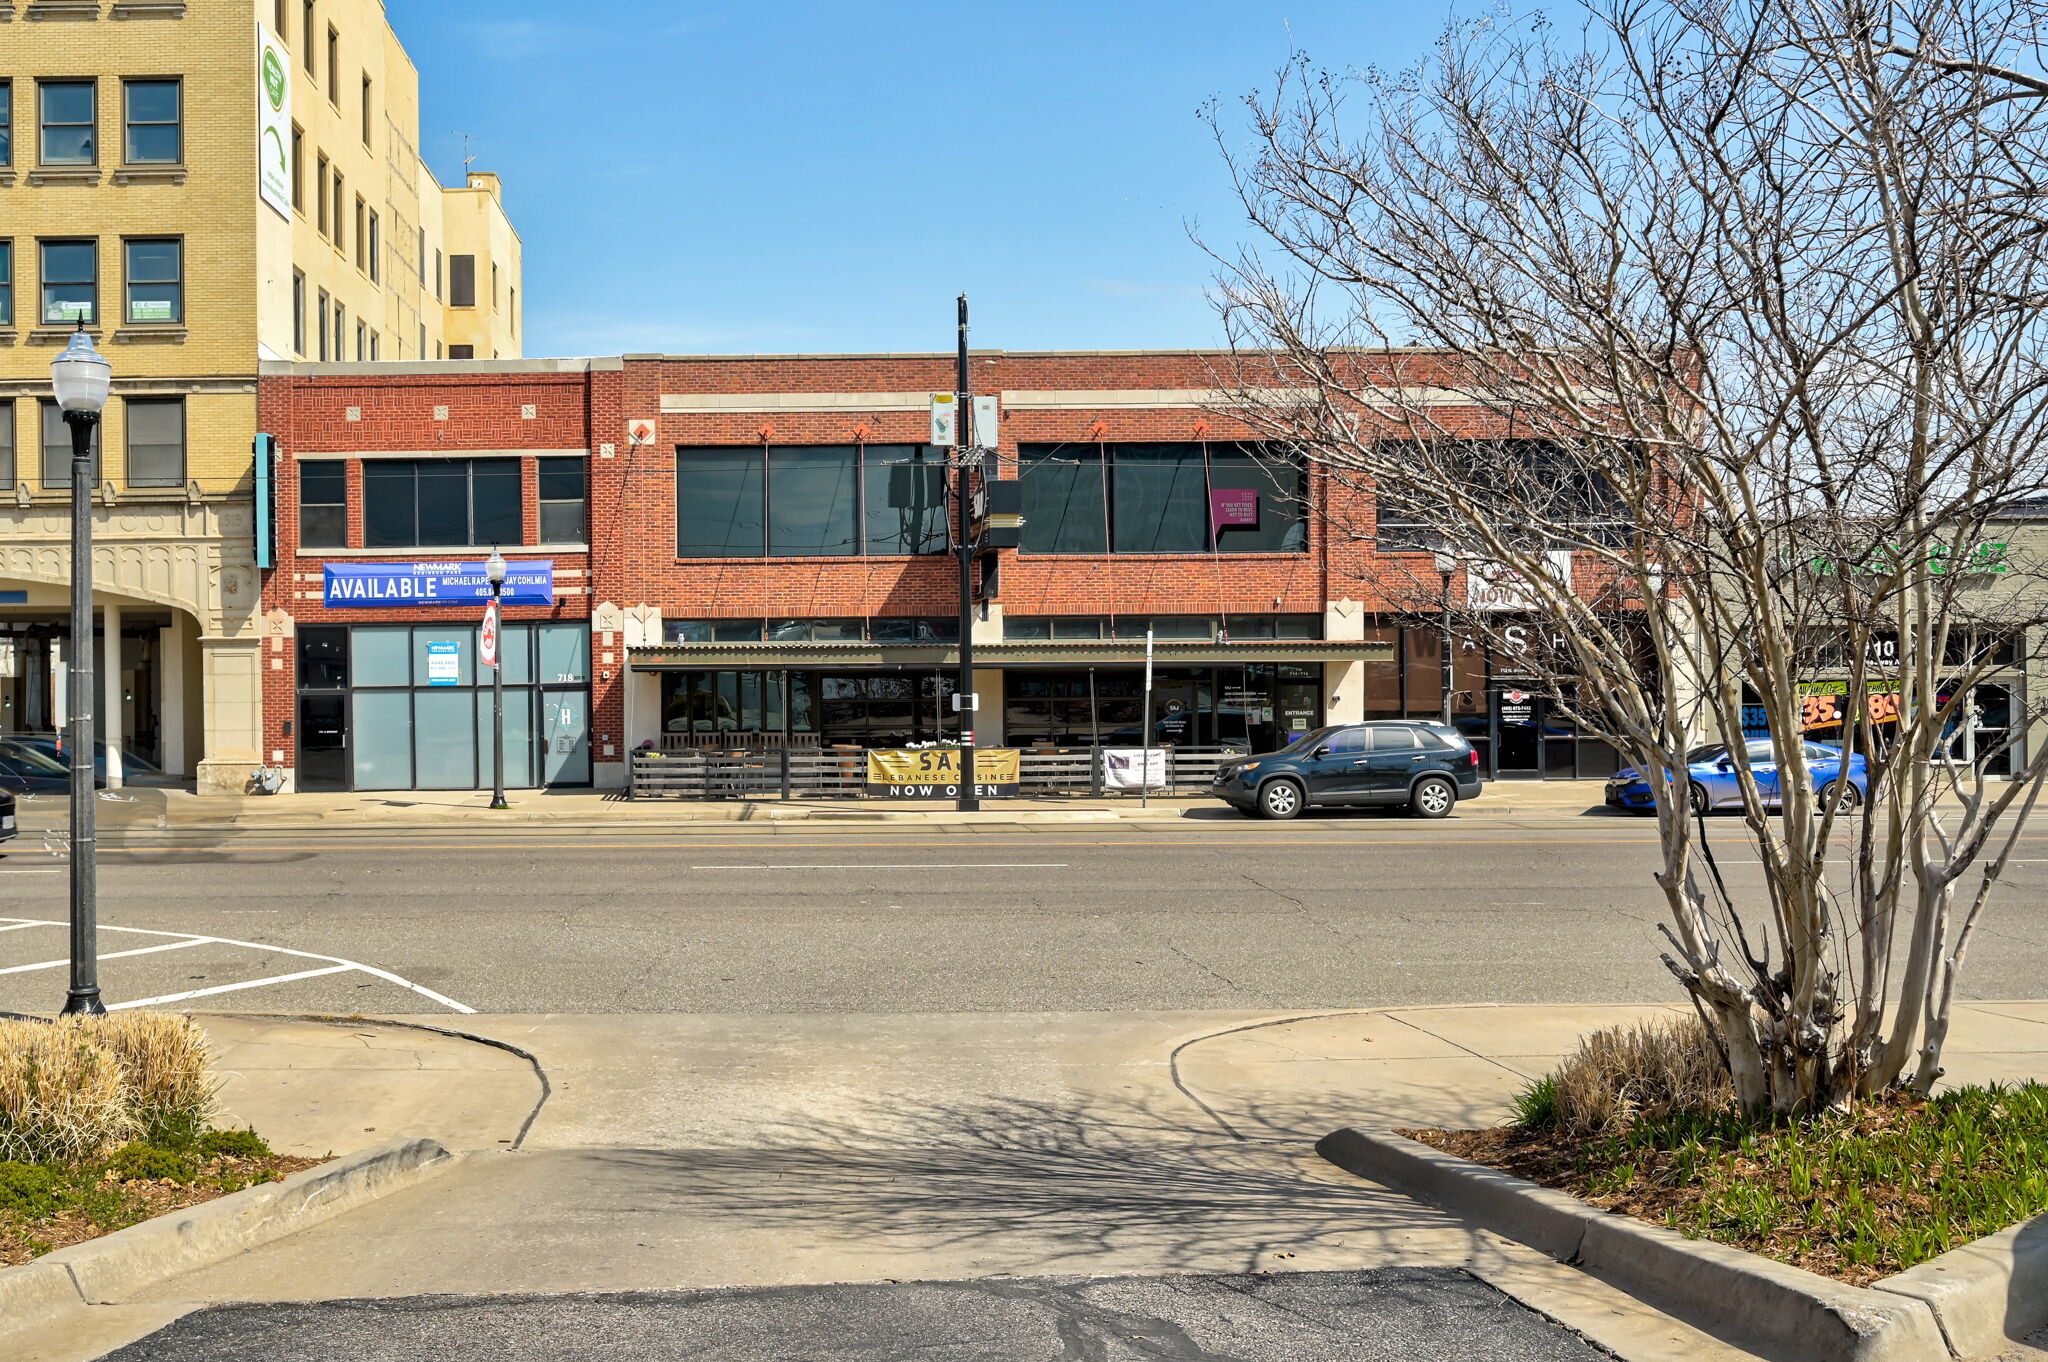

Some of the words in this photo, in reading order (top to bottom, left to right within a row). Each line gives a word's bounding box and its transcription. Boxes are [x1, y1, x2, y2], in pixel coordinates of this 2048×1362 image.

[413, 563, 462, 571] NEWMARK
[442, 577, 472, 586] MICHAEL
[505, 576, 518, 585] JAY
[518, 576, 547, 585] COHLMIA
[329, 577, 437, 598] AVAILABLE
[557, 673, 574, 682] 718
[561, 708, 571, 725] H
[919, 751, 961, 771] SA
[954, 773, 1005, 781] CSINE
[889, 785, 934, 796] NOW
[946, 785, 998, 796] OEN
